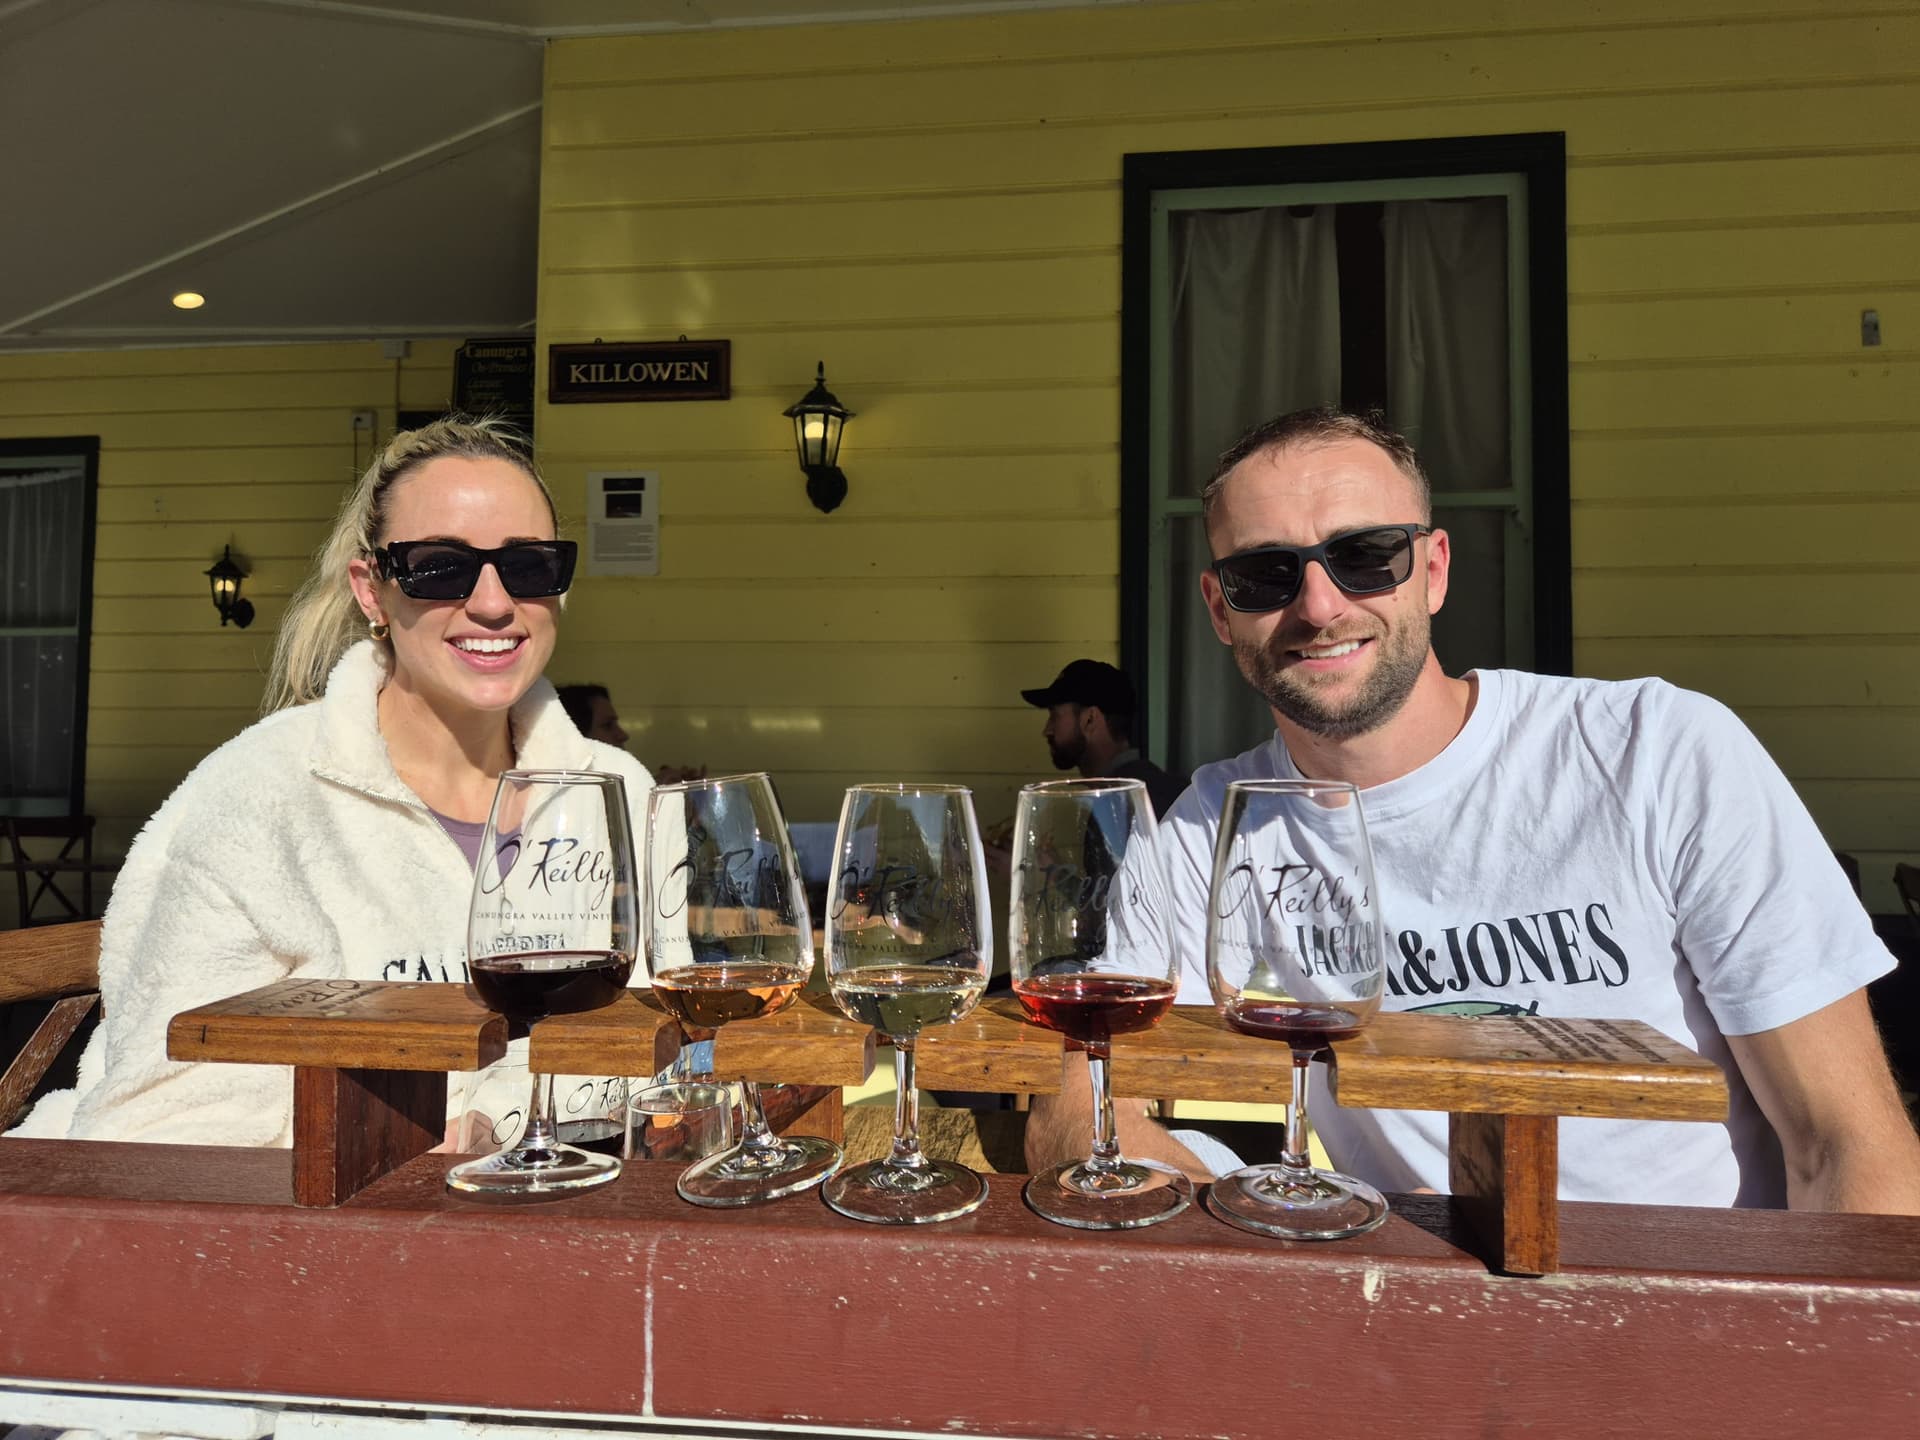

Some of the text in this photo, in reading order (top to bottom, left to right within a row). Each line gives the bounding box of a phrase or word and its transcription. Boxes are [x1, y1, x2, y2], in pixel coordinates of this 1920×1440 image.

[569, 361, 710, 384] KILLOWEN
[1216, 857, 1370, 944] O'Reilly's
[531, 911, 576, 921] VALLEY
